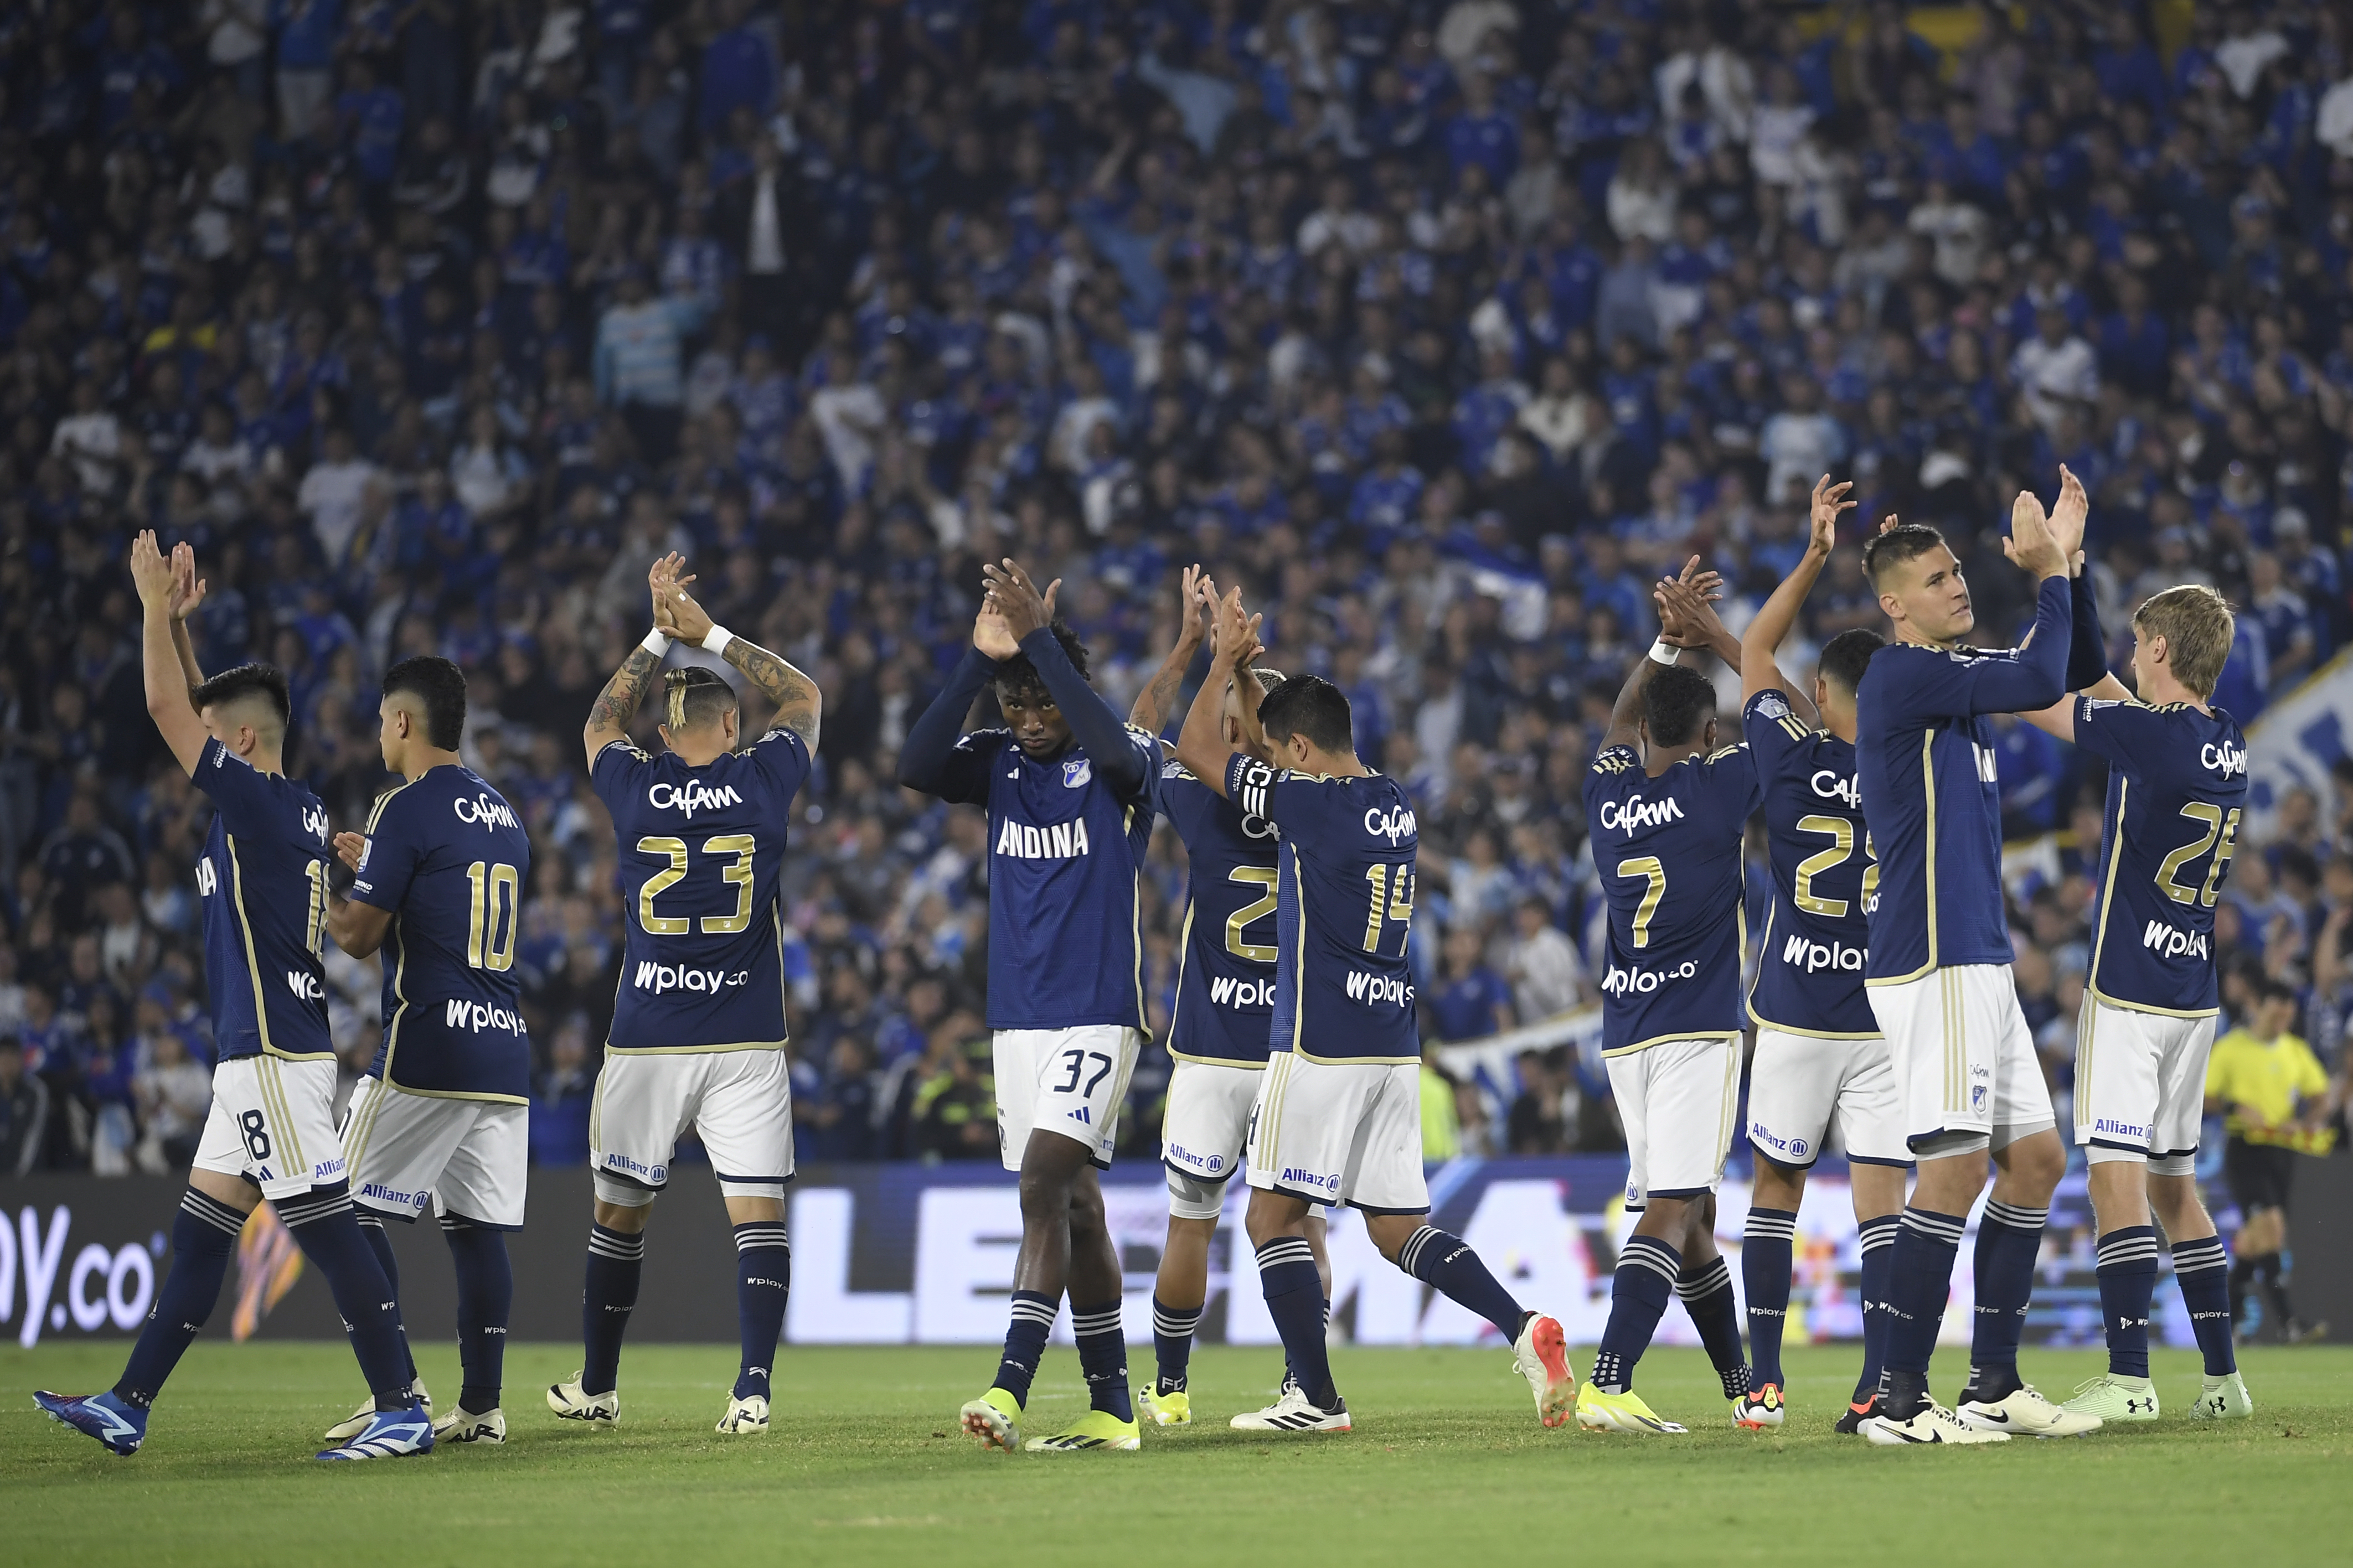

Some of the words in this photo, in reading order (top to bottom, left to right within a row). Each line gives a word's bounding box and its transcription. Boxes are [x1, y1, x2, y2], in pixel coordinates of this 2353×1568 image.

[997, 815, 1089, 858] ANDINA
[637, 834, 756, 935] 23
[1618, 856, 1666, 948] 7
[466, 861, 518, 972] 10
[1363, 864, 1416, 958] 14
[1053, 1049, 1112, 1098] 37
[1752, 1122, 1786, 1151] Allianz
[2094, 1119, 2144, 1137] Allianz
[608, 1153, 648, 1177] Allianz
[1169, 1142, 1203, 1167] Allianz
[361, 1183, 411, 1204] Allianz
[1282, 1167, 1325, 1187] Allianz
